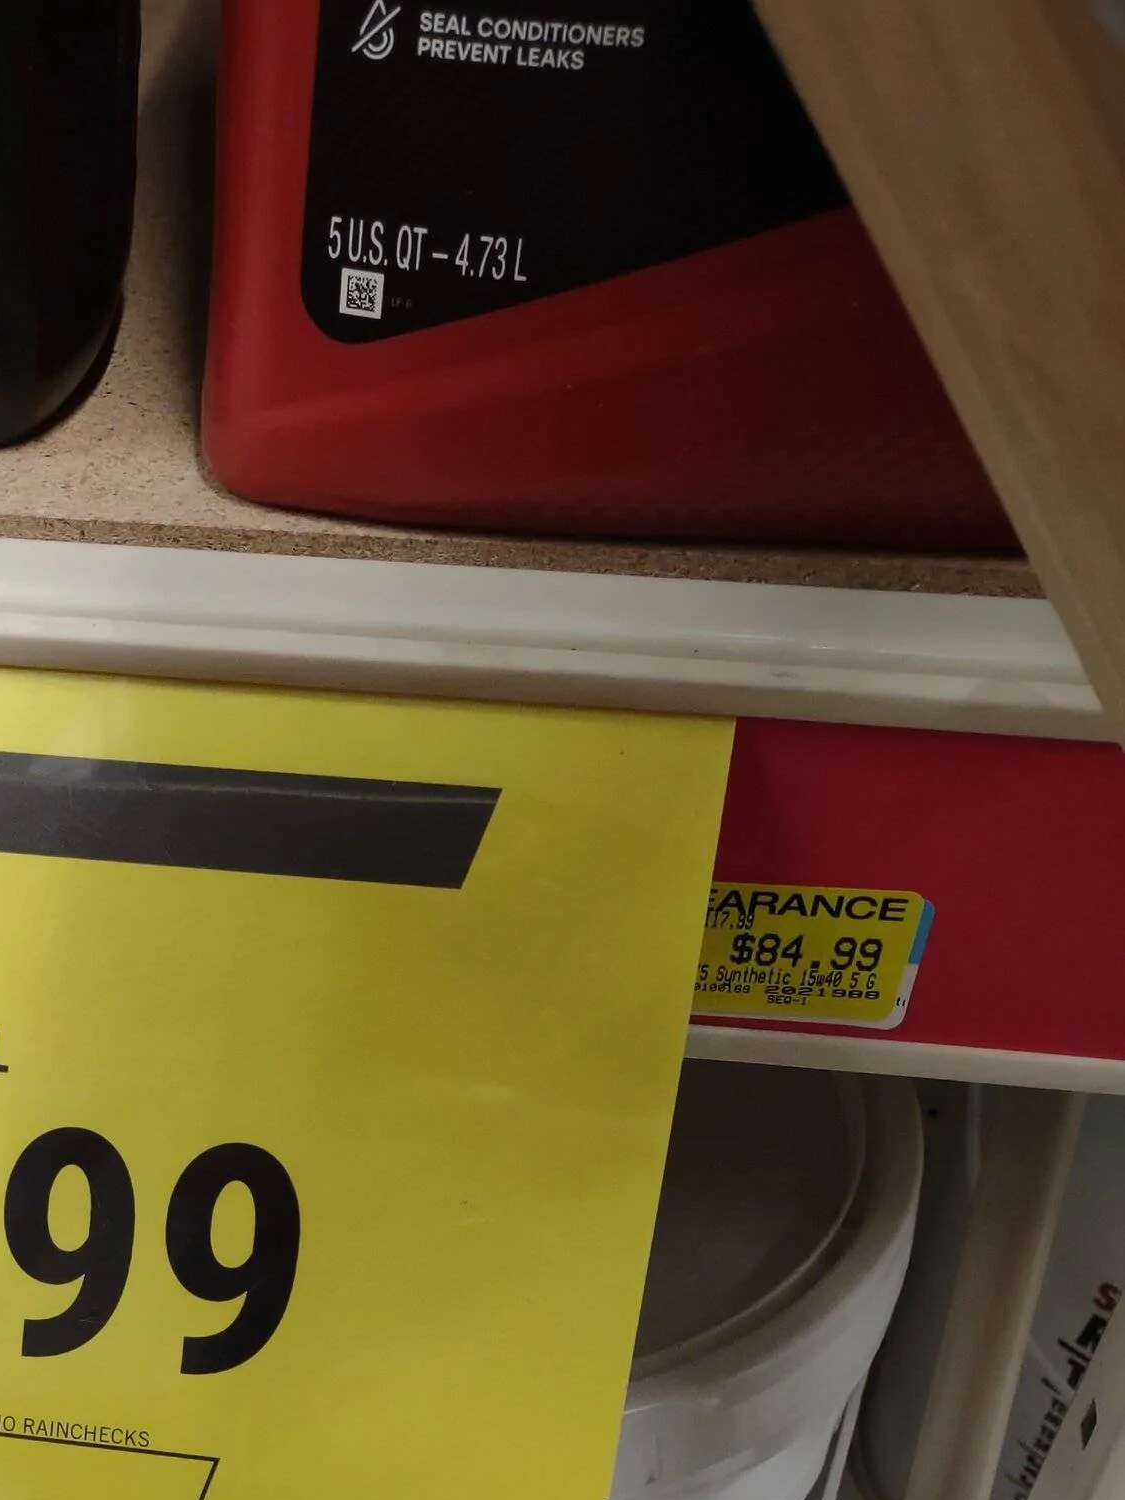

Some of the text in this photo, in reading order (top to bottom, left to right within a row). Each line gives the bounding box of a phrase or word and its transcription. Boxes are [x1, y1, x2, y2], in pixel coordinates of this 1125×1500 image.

[419, 11, 645, 48] SEAL CONDITIONERS
[417, 37, 585, 71] PREVENT LEAKS
[328, 216, 343, 259] 5
[348, 218, 389, 268] U.S.
[396, 224, 428, 272] QT
[455, 233, 508, 281] 4.73
[513, 237, 528, 282] L
[730, 931, 884, 972] $84.99
[716, 965, 792, 986] Synthetic
[800, 968, 843, 988] 15w40
[850, 972, 860, 990] 5
[866, 972, 877, 990] G
[765, 985, 881, 1000] 2021988
[22, 1417, 151, 1449] RAINCHECKS
